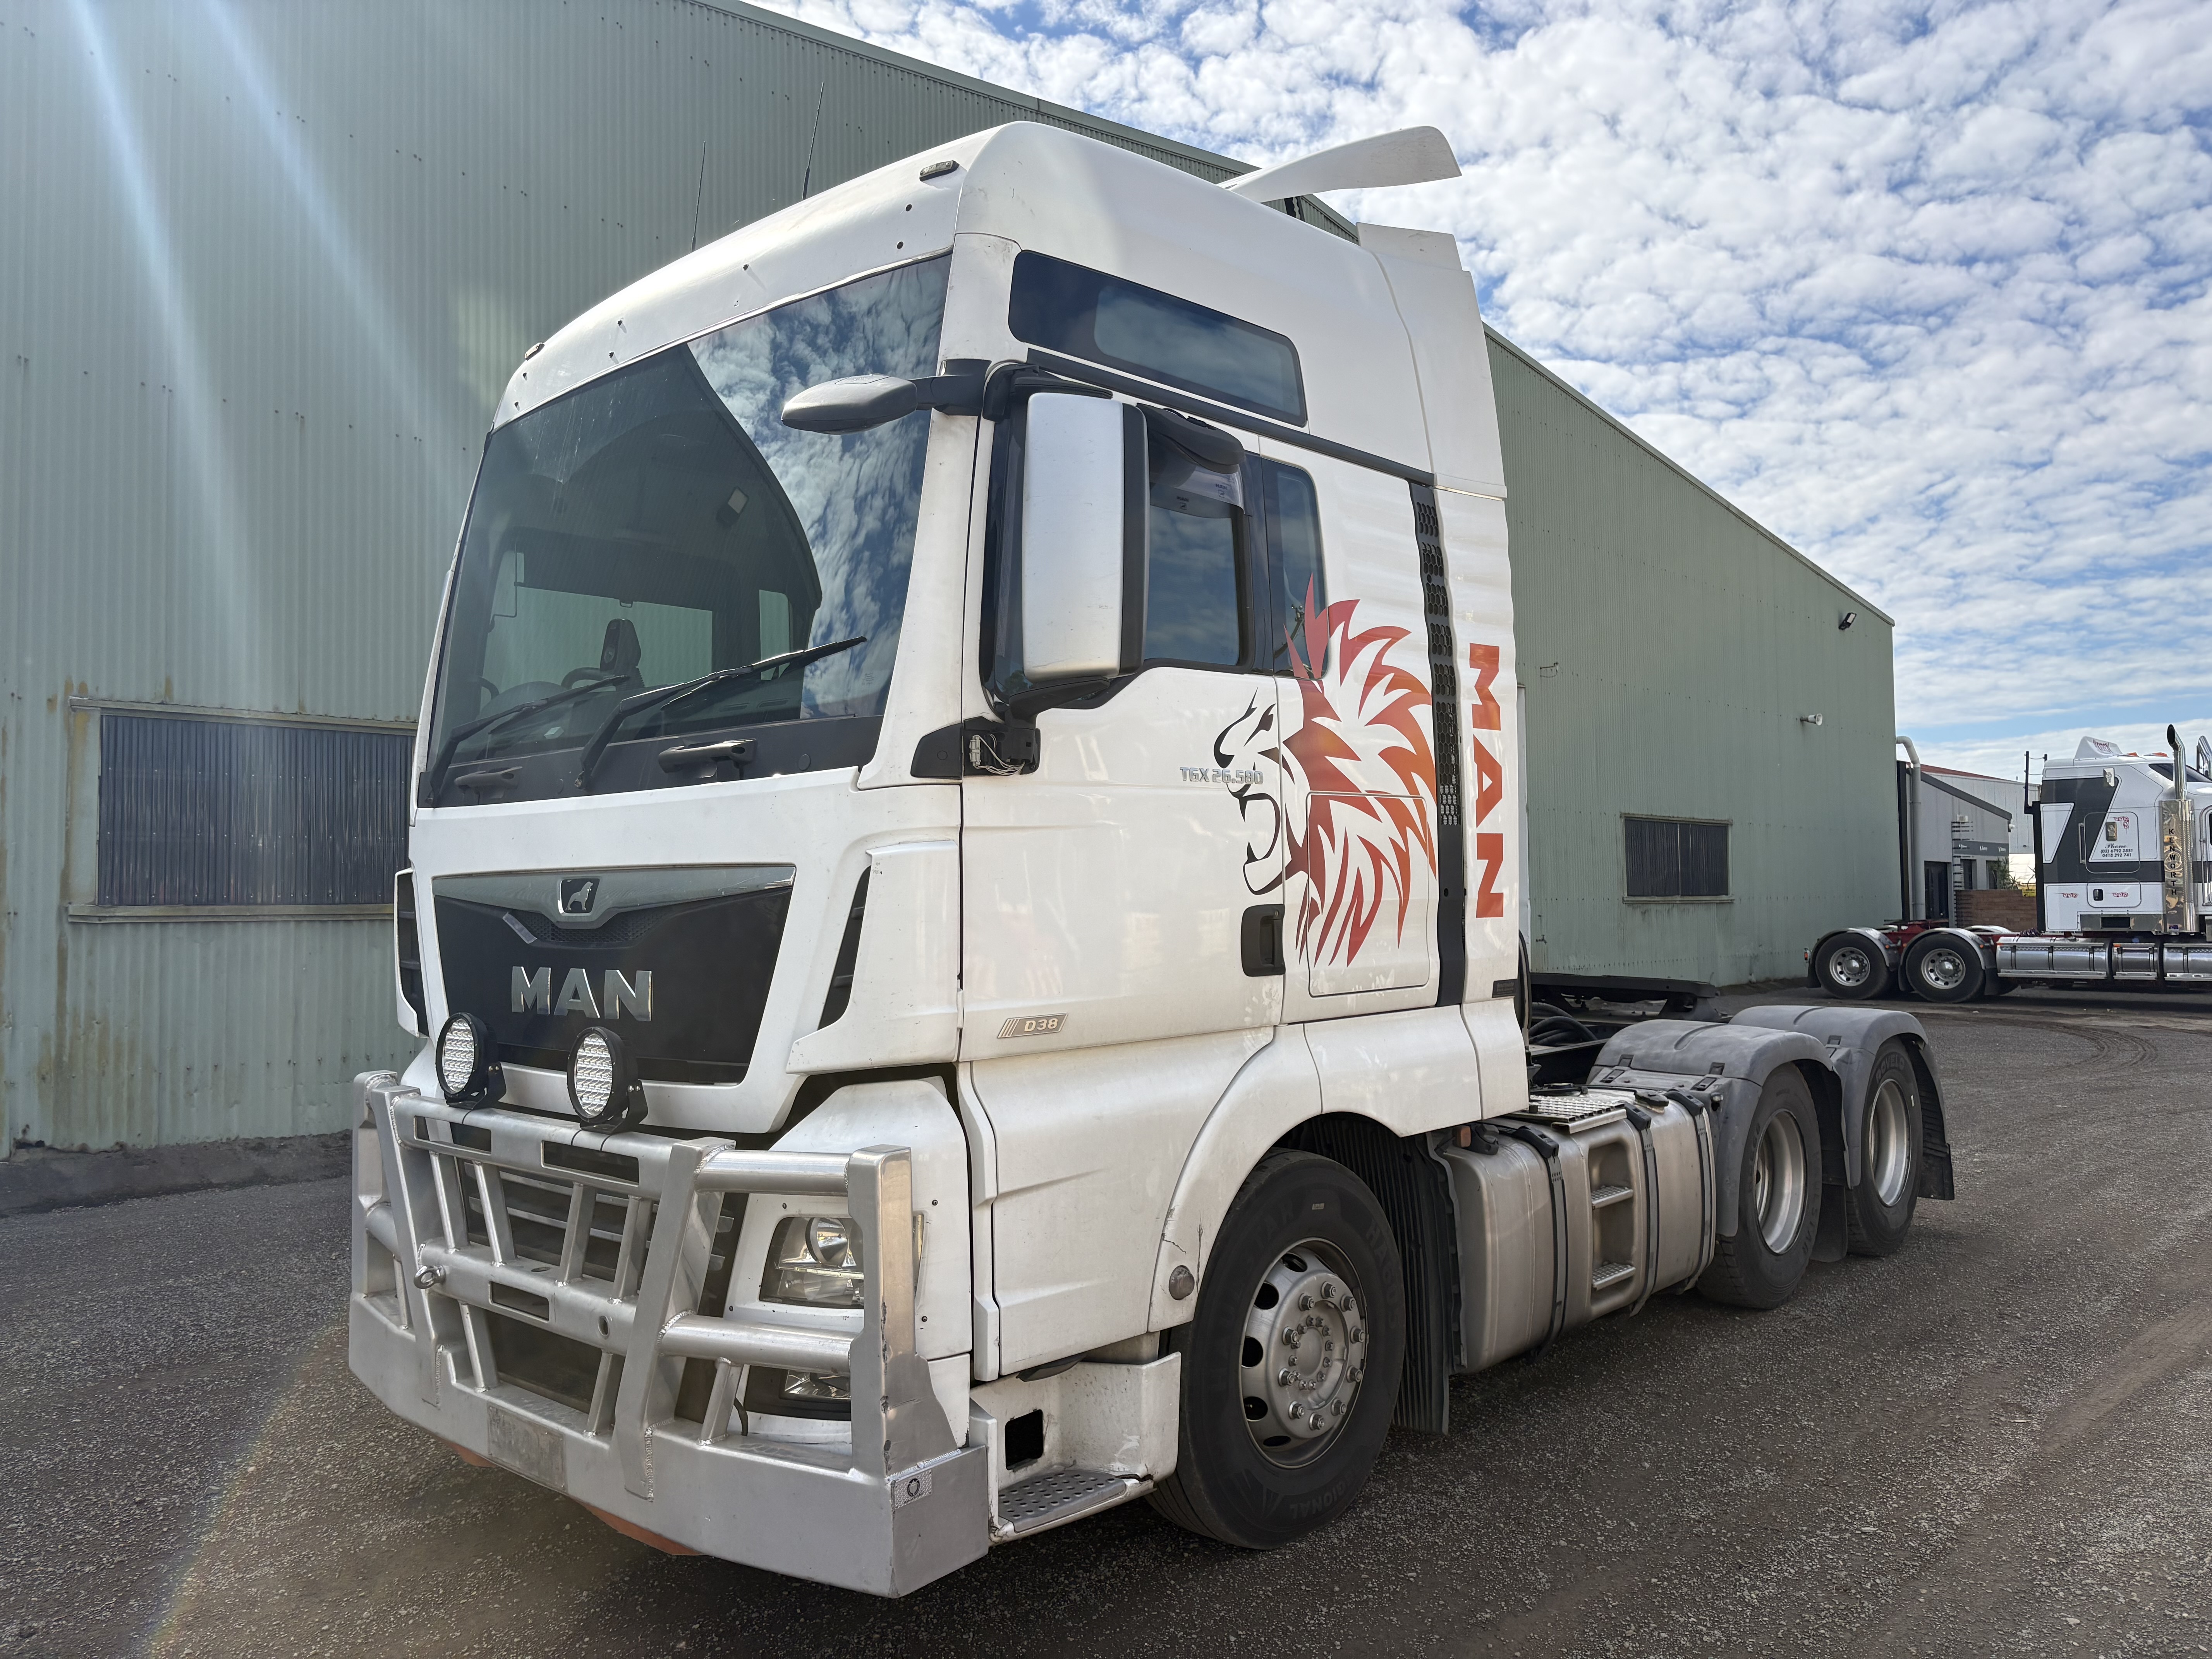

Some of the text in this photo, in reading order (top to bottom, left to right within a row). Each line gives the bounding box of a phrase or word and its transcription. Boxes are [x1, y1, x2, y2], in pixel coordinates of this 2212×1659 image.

[1180, 767, 1264, 785] TGX 26.580
[1469, 642, 1504, 918] MAN
[2169, 828, 2177, 895] KENWORTH
[511, 965, 653, 1022] MAN
[1024, 1018, 1058, 1032] D38
[1875, 1054, 1905, 1084] ROVELO
